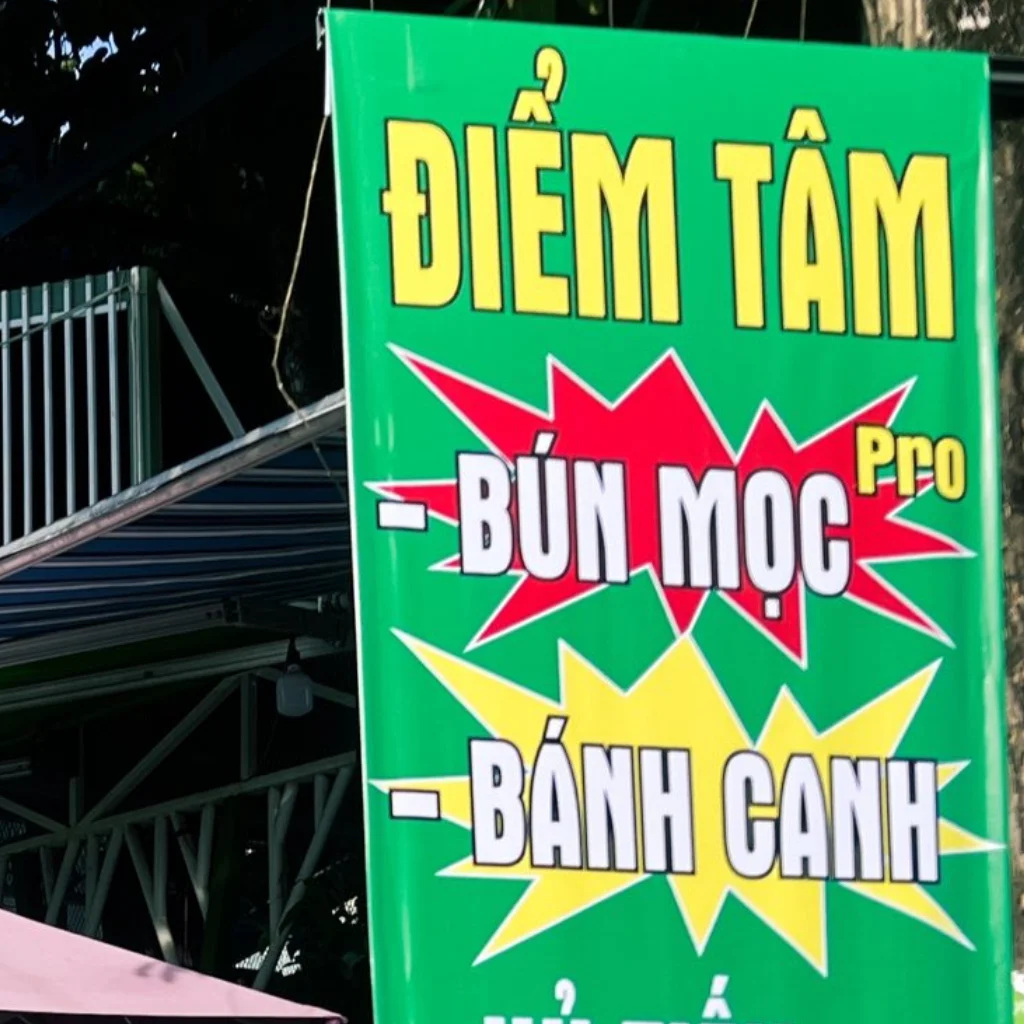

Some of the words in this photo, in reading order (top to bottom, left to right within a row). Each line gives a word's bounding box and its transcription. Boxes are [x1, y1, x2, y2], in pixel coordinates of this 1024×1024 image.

[381, 45, 682, 325] ĐIỂM
[713, 105, 955, 341] TÂM
[455, 430, 630, 584] BÚN
[656, 465, 852, 621] MỌC
[855, 423, 965, 501] Pro
[468, 716, 696, 874] BÁNH
[722, 748, 941, 884] CANH
